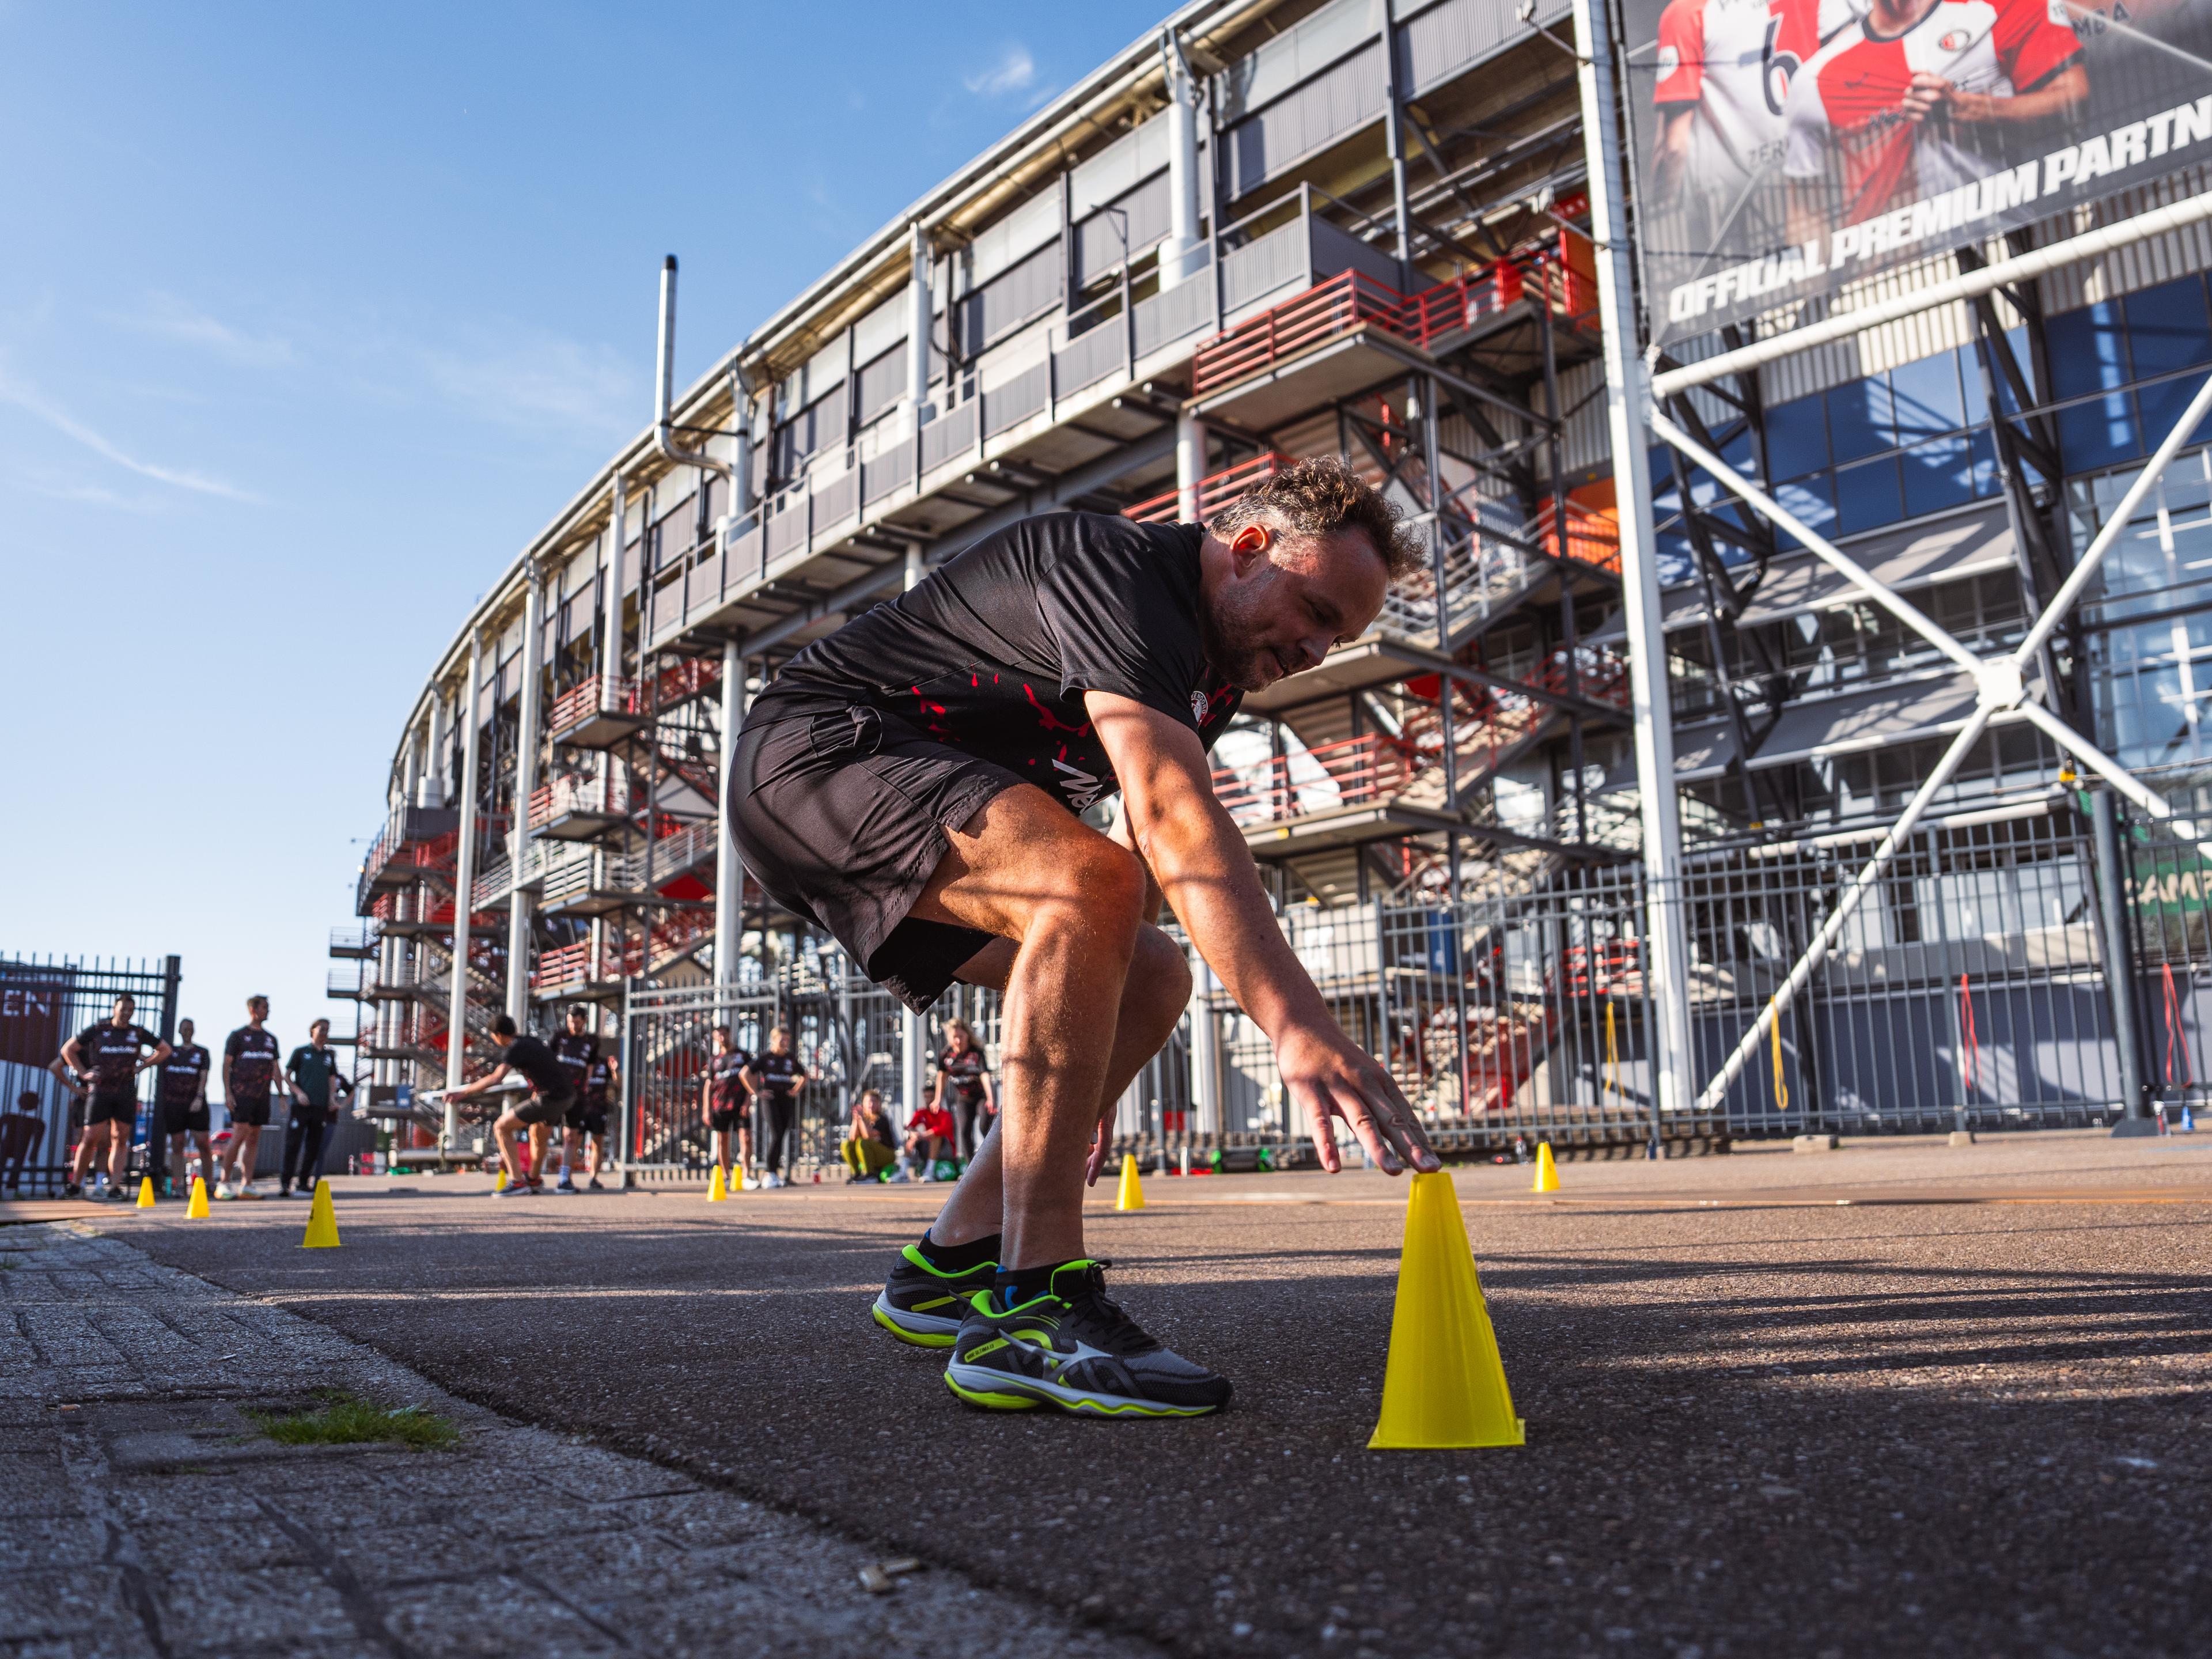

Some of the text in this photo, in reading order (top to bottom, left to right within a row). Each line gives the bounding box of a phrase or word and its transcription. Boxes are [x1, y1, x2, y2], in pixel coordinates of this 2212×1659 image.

[1670, 93, 2212, 323] OFFICIAL PREMIUM PARTN
